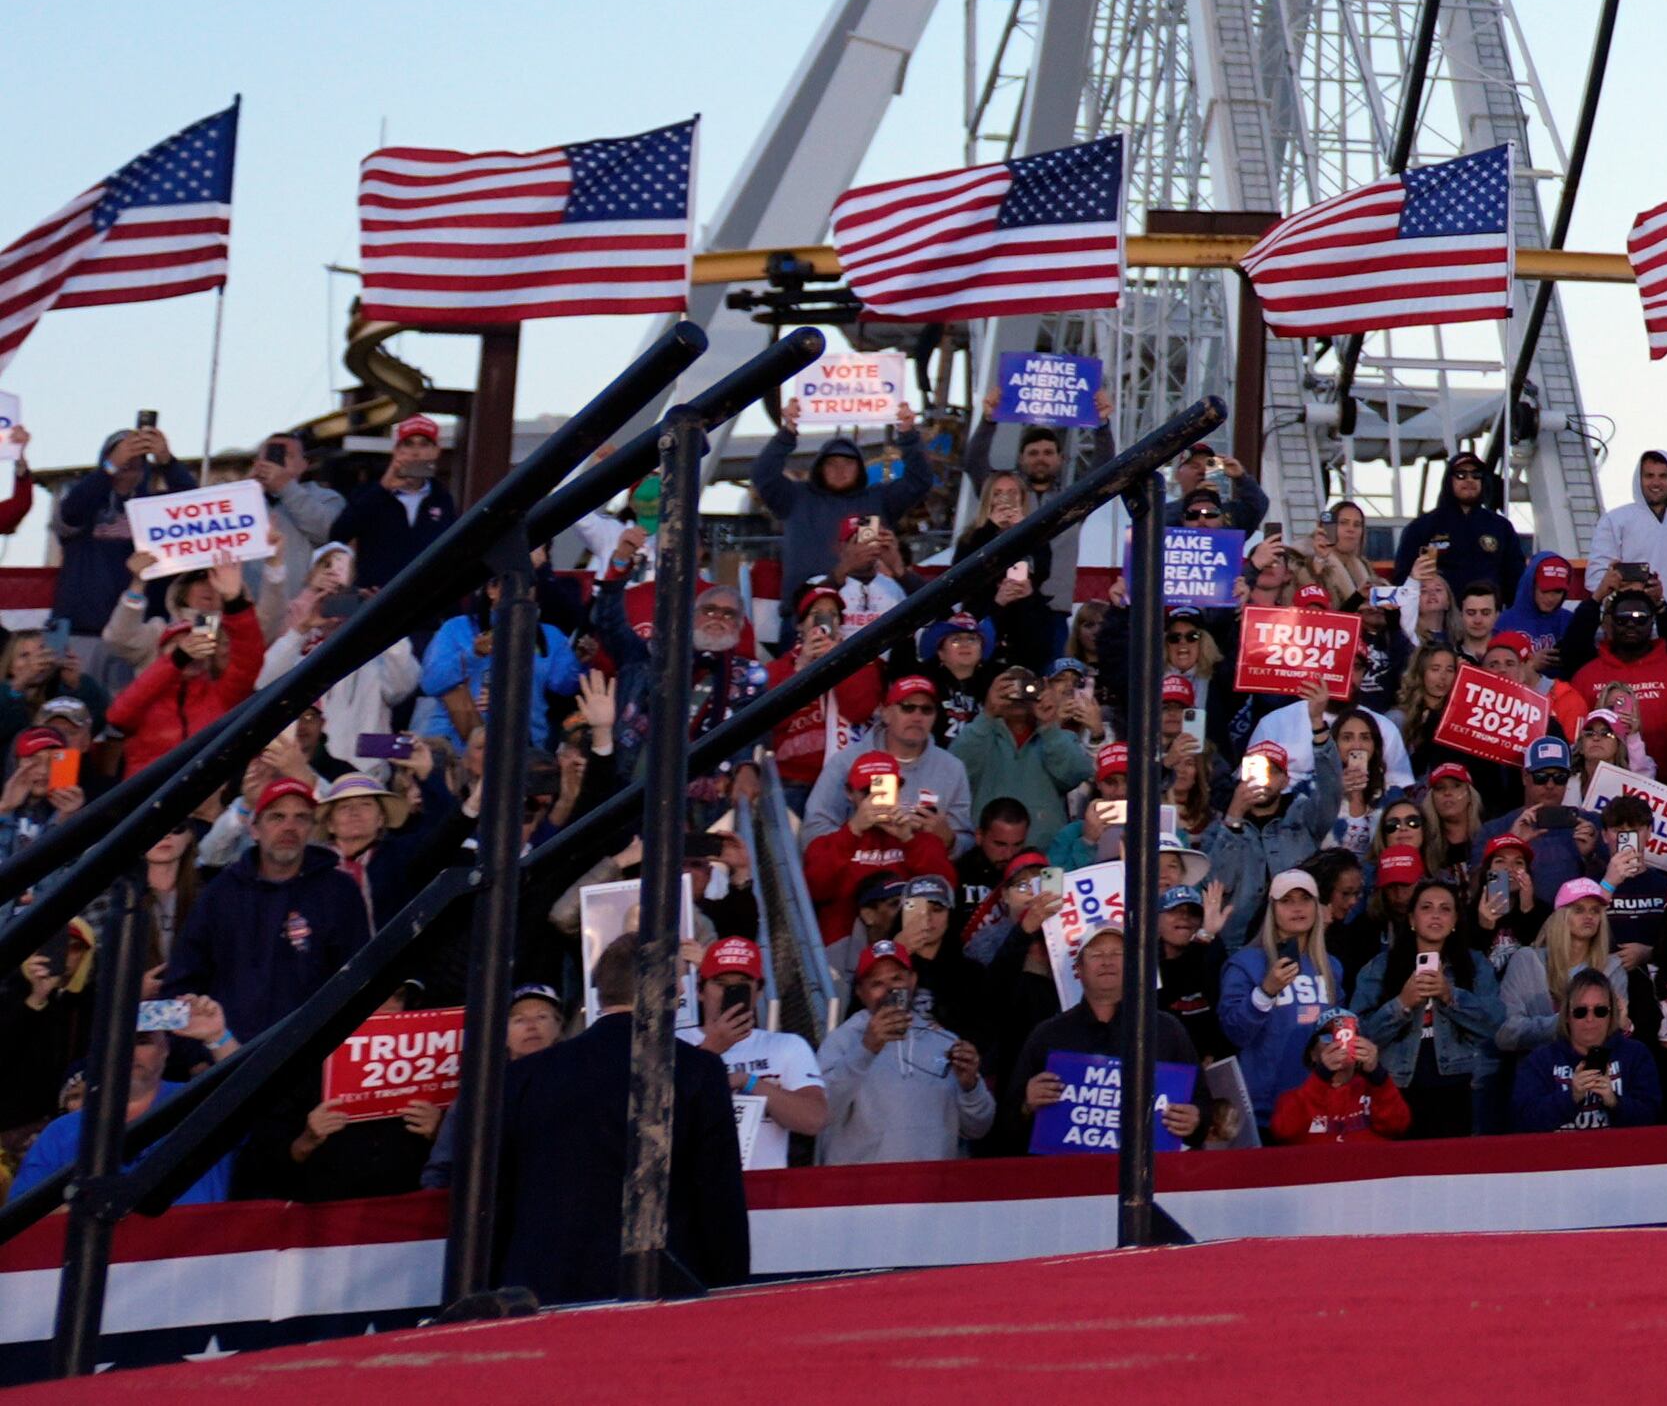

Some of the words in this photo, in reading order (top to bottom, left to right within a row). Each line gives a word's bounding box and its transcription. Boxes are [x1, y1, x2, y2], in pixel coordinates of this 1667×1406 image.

[821, 365, 879, 379] VOTE
[1025, 359, 1076, 375] MAKE
[803, 381, 895, 396] DONALD
[1008, 373, 1089, 391] AMERICA
[1017, 388, 1078, 402] GREAT
[811, 398, 888, 414] TRUMP
[1015, 401, 1078, 417] AGAIN!
[165, 500, 233, 520] VOTE
[149, 514, 255, 541] DONALD
[161, 532, 251, 557] TRUMP
[1164, 551, 1227, 566] ERICA
[1164, 566, 1216, 580] REAT
[1164, 582, 1215, 596] GAIN!
[1301, 585, 1324, 597] USA
[1255, 622, 1350, 649] TRUMP
[1265, 646, 1335, 669] 2024
[1465, 682, 1541, 724] TRUMP
[1635, 691, 1660, 700] GAIN
[1466, 707, 1529, 742] 2024
[1609, 897, 1664, 909] RUMP
[344, 1028, 464, 1062] TRUM
[360, 1054, 460, 1088] 2024
[1084, 1066, 1121, 1087] MA
[374, 1085, 419, 1098] TRUMP
[1071, 1106, 1121, 1128] GRE
[1062, 1126, 1121, 1149] AGA
